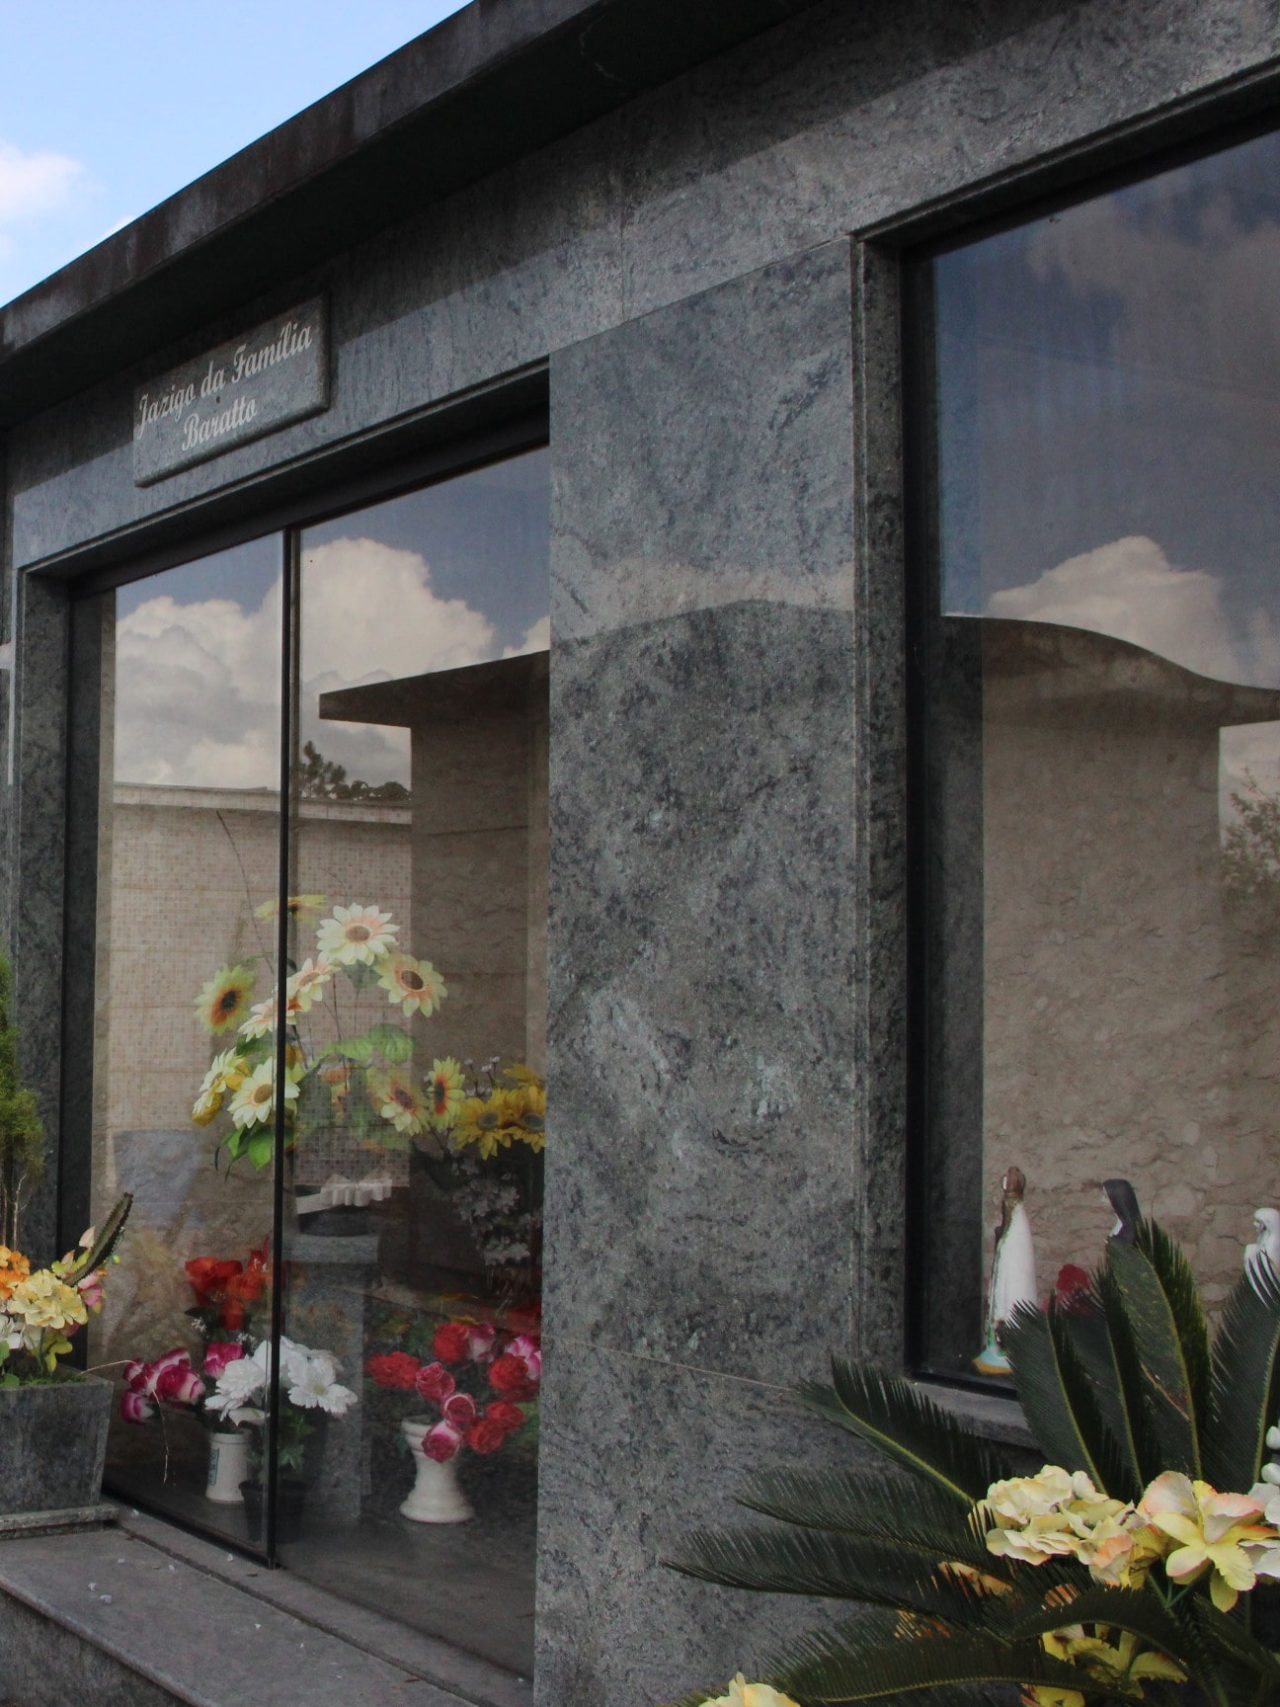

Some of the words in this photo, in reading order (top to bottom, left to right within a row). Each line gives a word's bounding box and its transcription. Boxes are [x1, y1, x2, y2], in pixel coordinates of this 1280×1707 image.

[136, 383, 196, 441] Jazigo
[200, 360, 226, 398] da
[181, 394, 258, 452] Baratto
